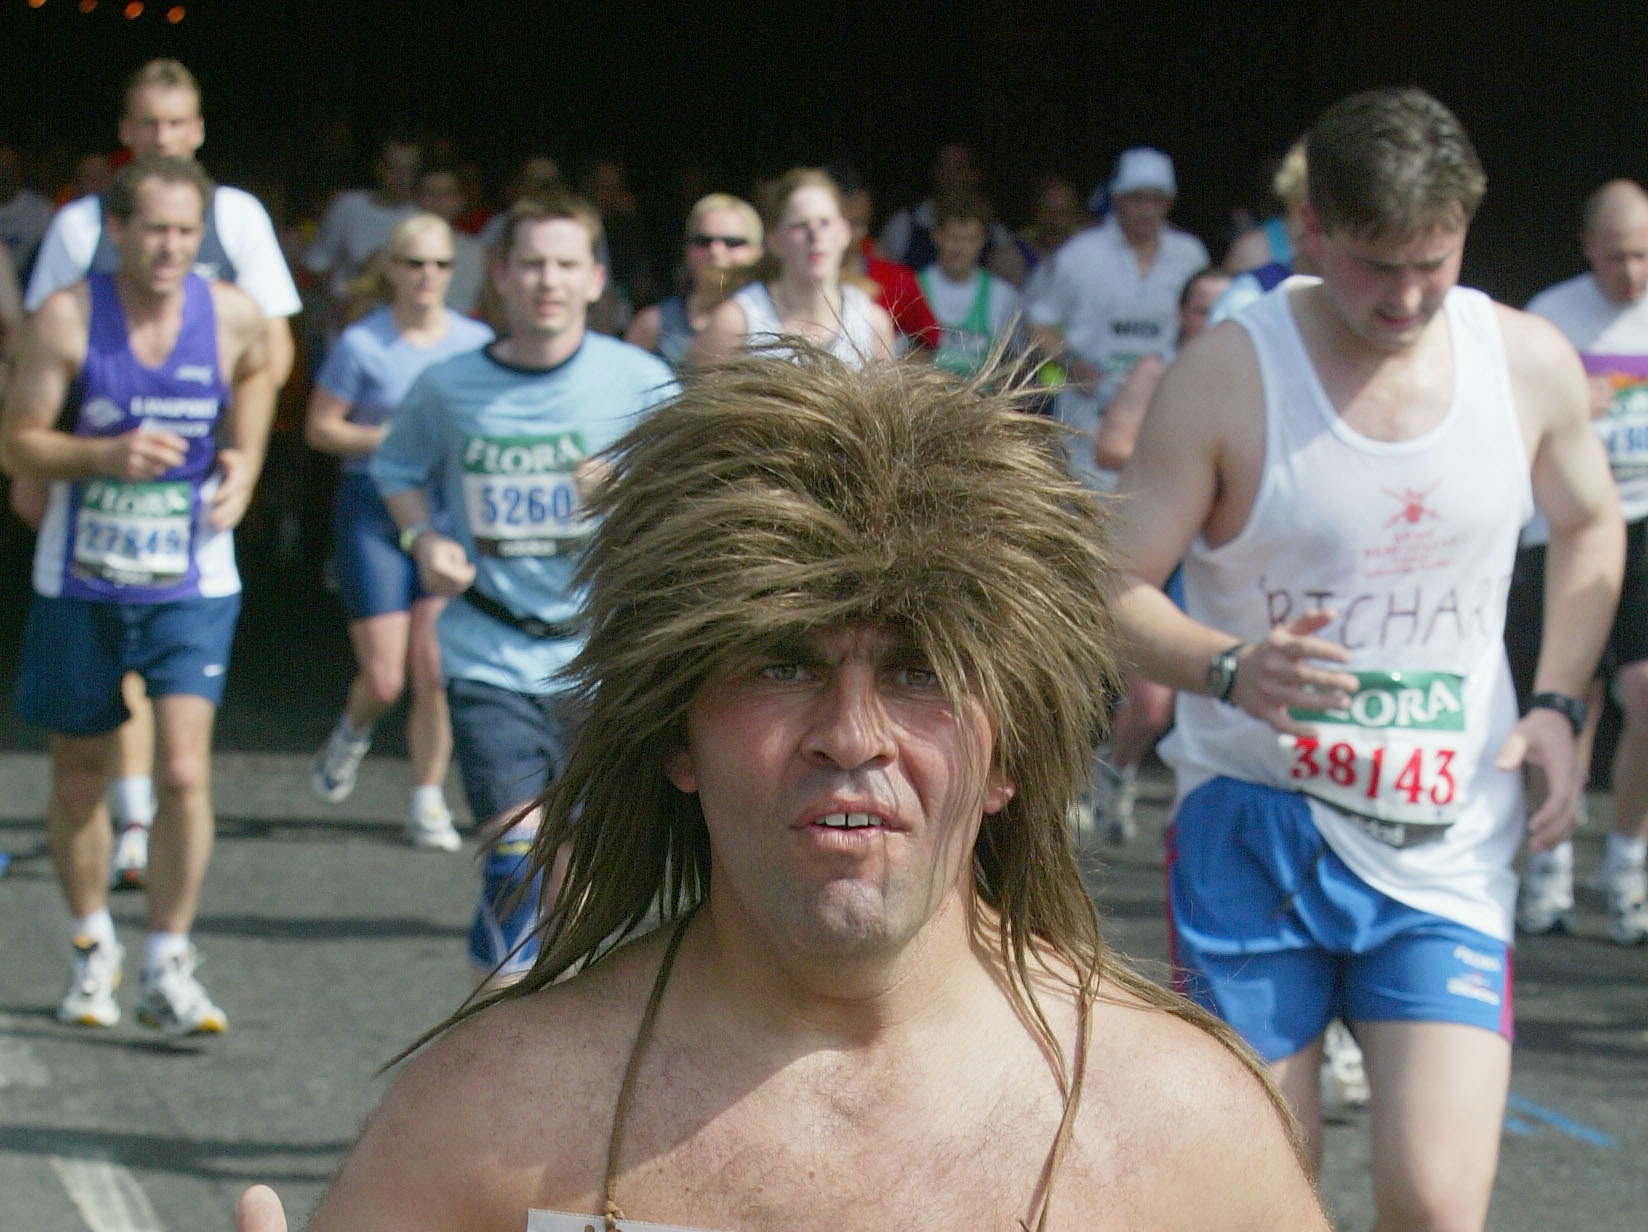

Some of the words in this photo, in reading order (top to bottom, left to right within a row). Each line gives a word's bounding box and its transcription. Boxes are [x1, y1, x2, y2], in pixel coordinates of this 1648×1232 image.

[465, 434, 583, 474] FLORA
[1326, 680, 1460, 727] ORA
[1291, 737, 1457, 806] 38143
